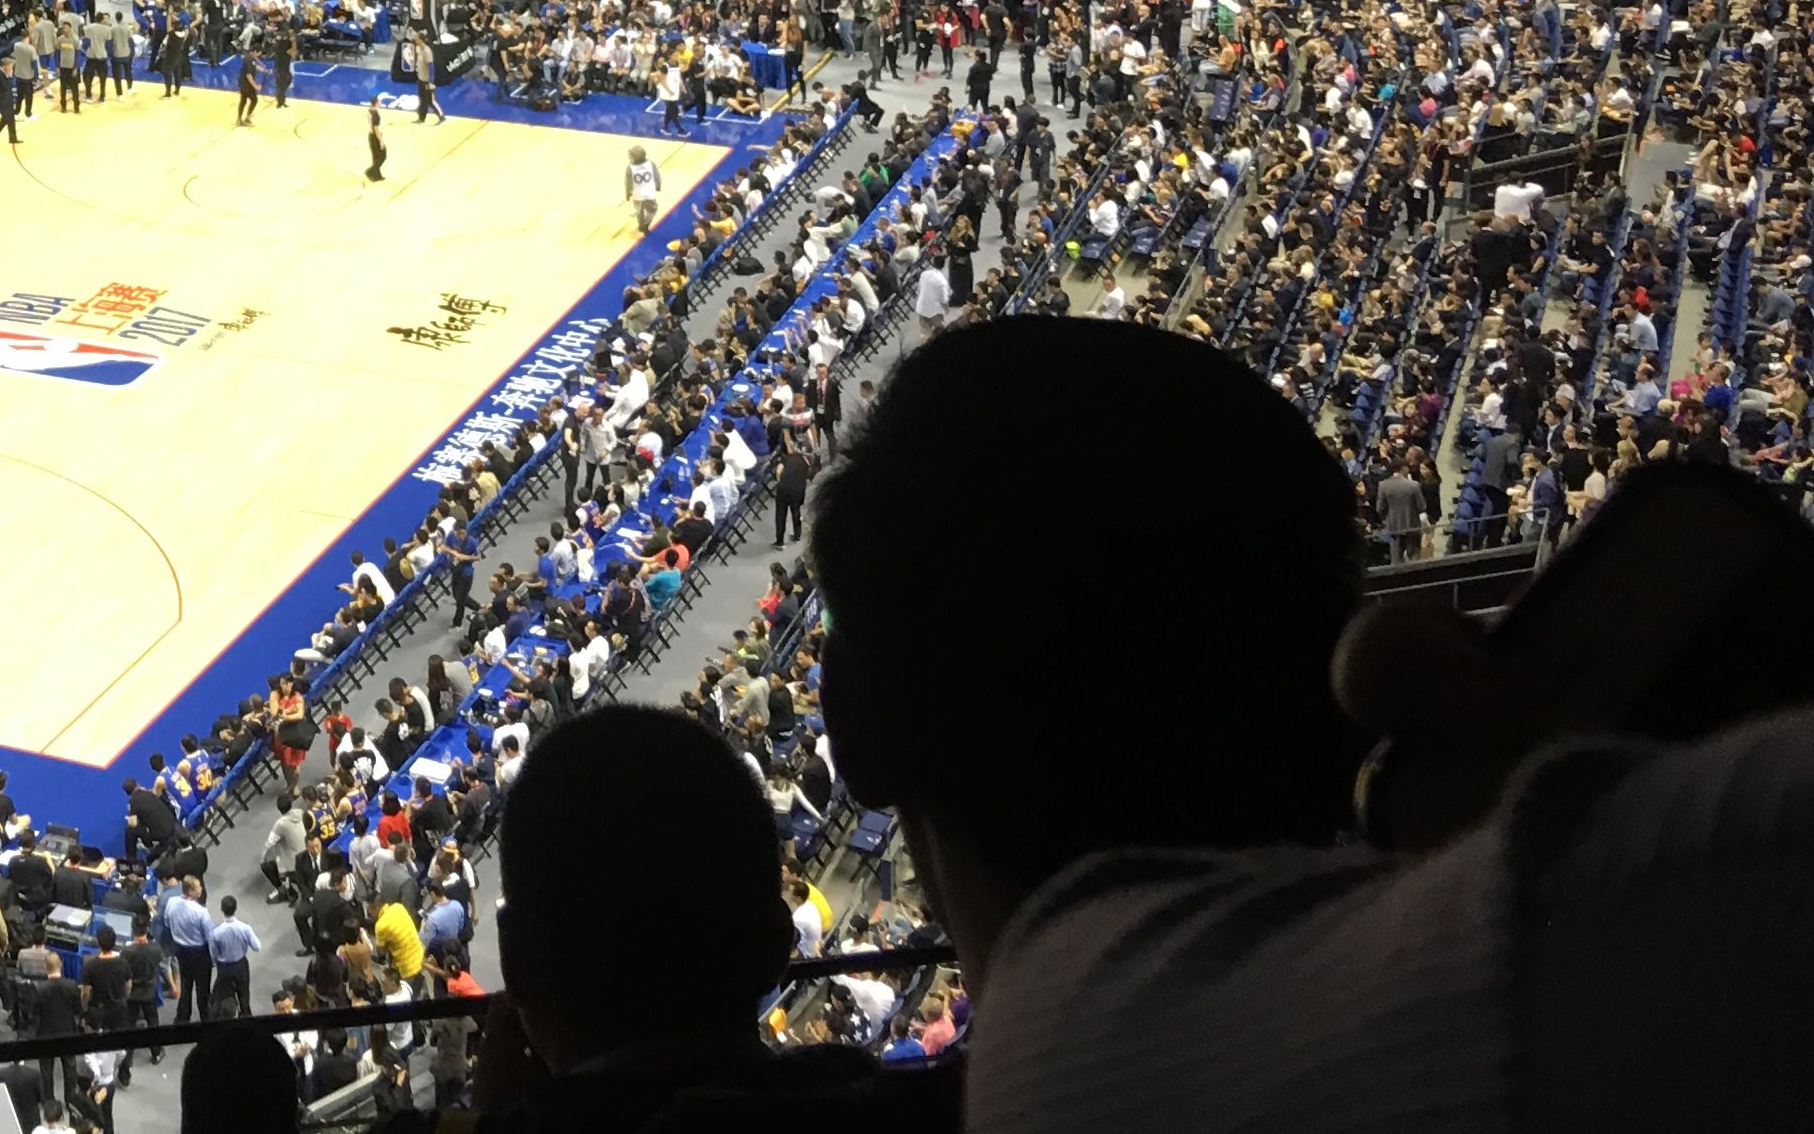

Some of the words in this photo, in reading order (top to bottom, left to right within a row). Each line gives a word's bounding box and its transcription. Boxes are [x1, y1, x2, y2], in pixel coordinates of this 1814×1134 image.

[633, 171, 652, 184] 00
[55, 282, 169, 336] 上海赛
[118, 305, 212, 347] 2017
[196, 769, 212, 791] 30
[320, 822, 336, 840] 35
